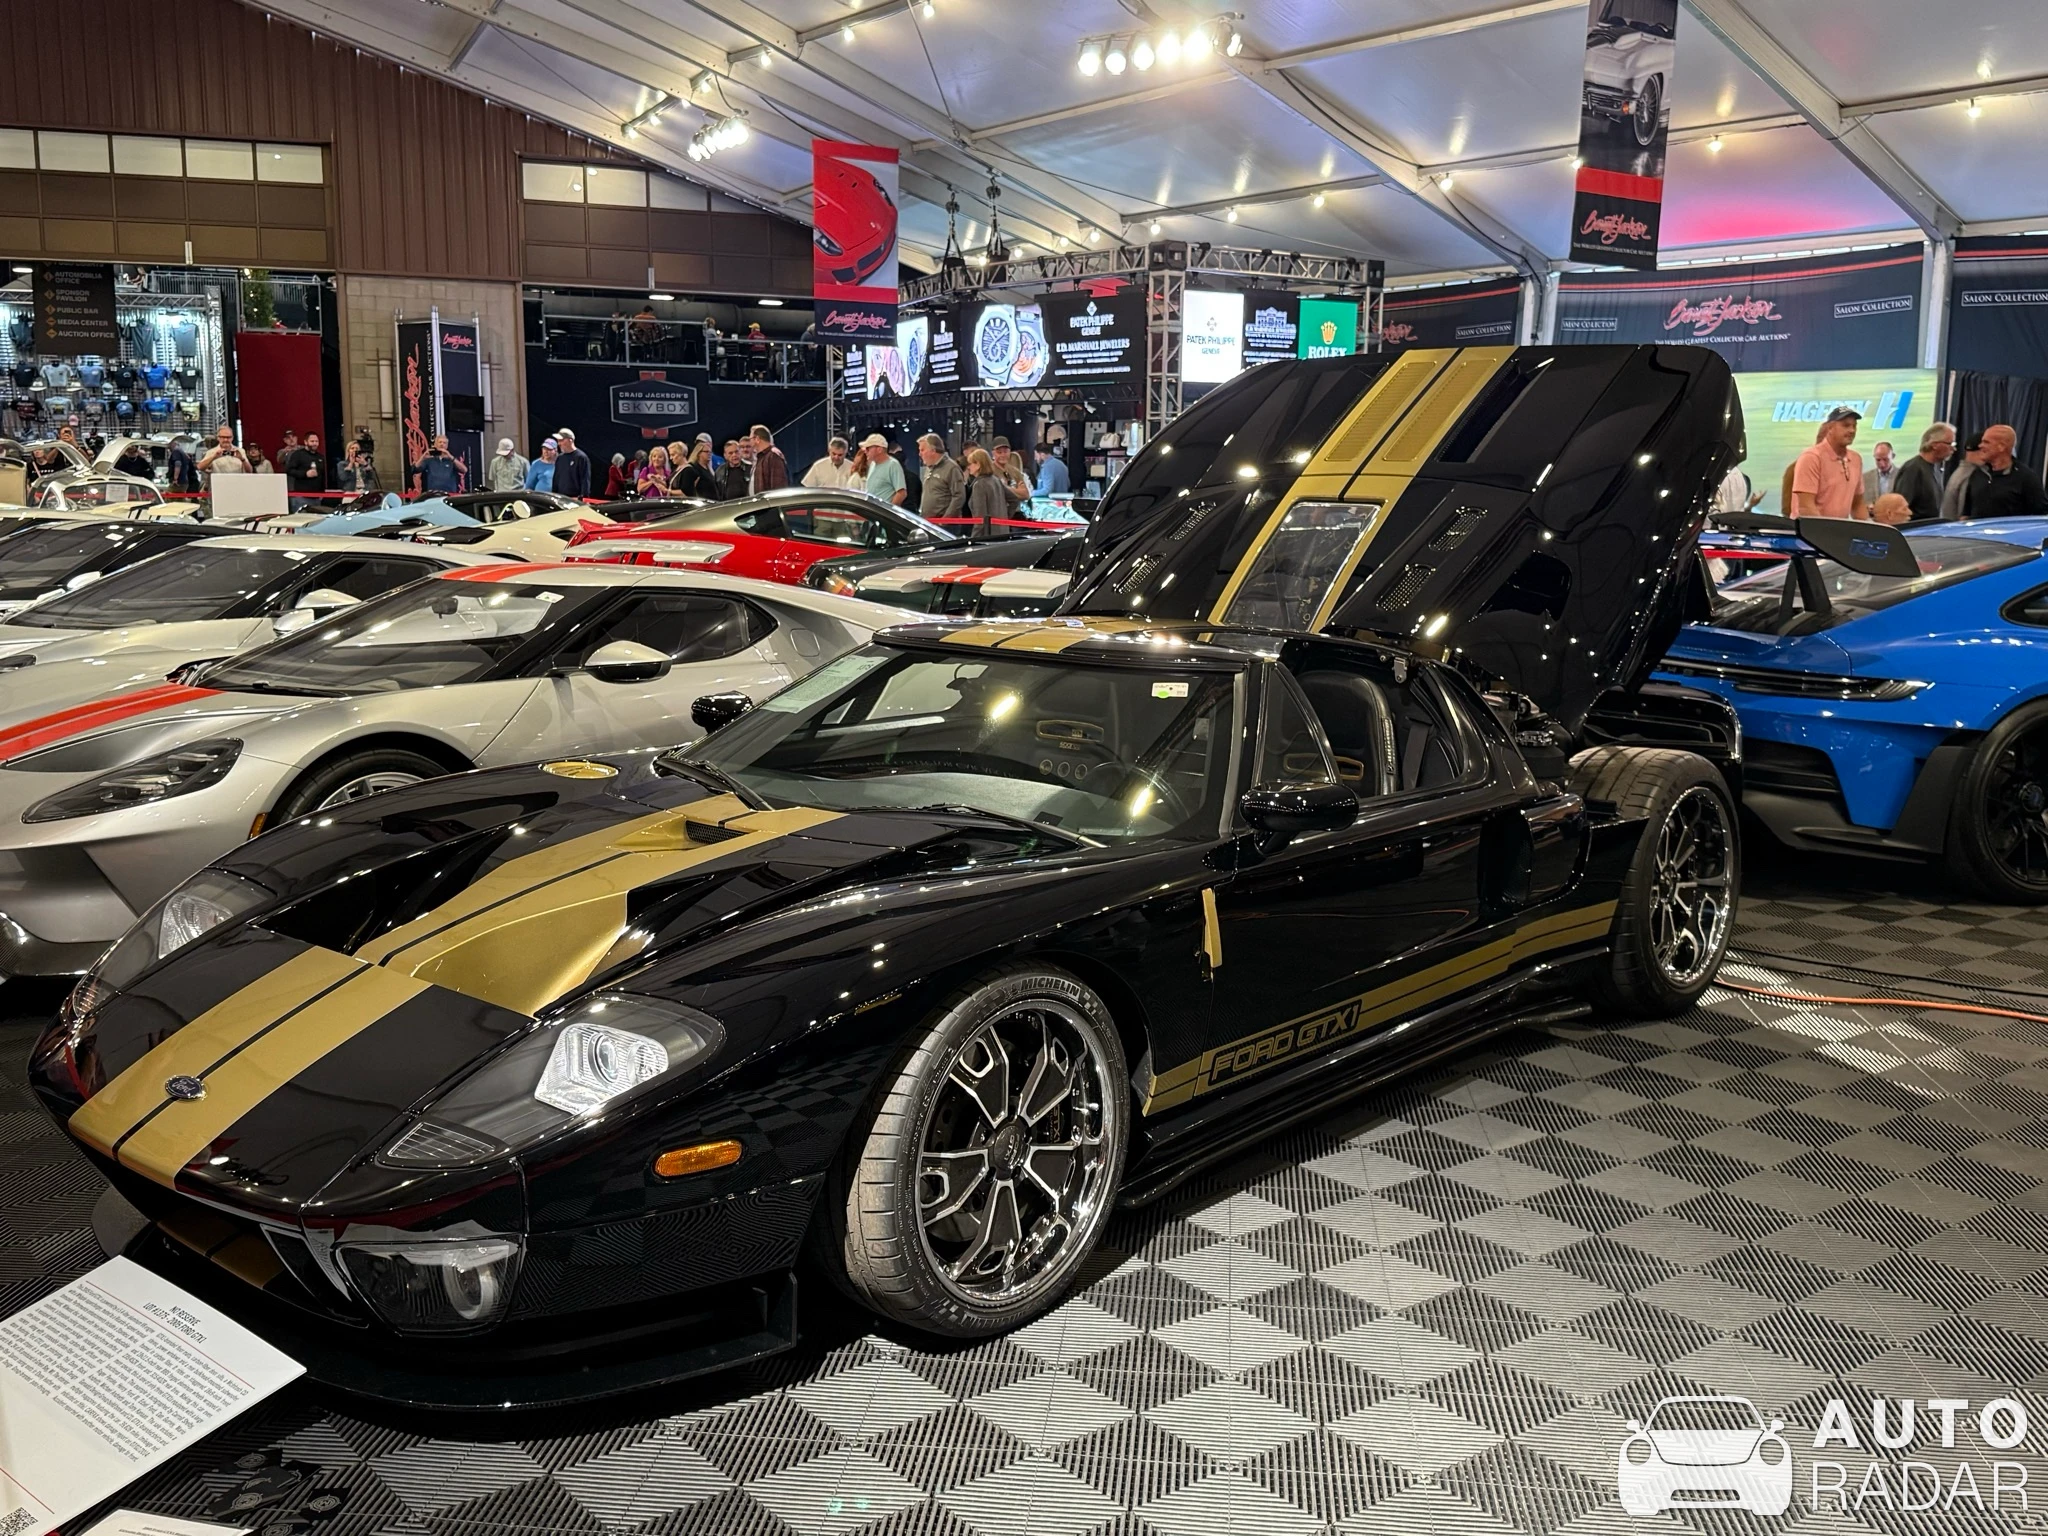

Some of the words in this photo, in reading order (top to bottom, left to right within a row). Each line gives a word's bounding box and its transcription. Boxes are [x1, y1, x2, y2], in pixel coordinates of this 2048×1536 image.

[1963, 294, 1992, 303] SALON
[1994, 292, 2048, 303] COLLECTION
[1835, 303, 1860, 315] SALON
[1861, 299, 1911, 312] COLLECTION
[90, 331, 115, 339] OFFICE
[1308, 346, 1348, 359] ROLEX
[621, 402, 687, 413] SKYBOX
[1021, 977, 1080, 997] MICHELIN
[1211, 1029, 1294, 1080] FORD
[1296, 1004, 1359, 1047] GTX1
